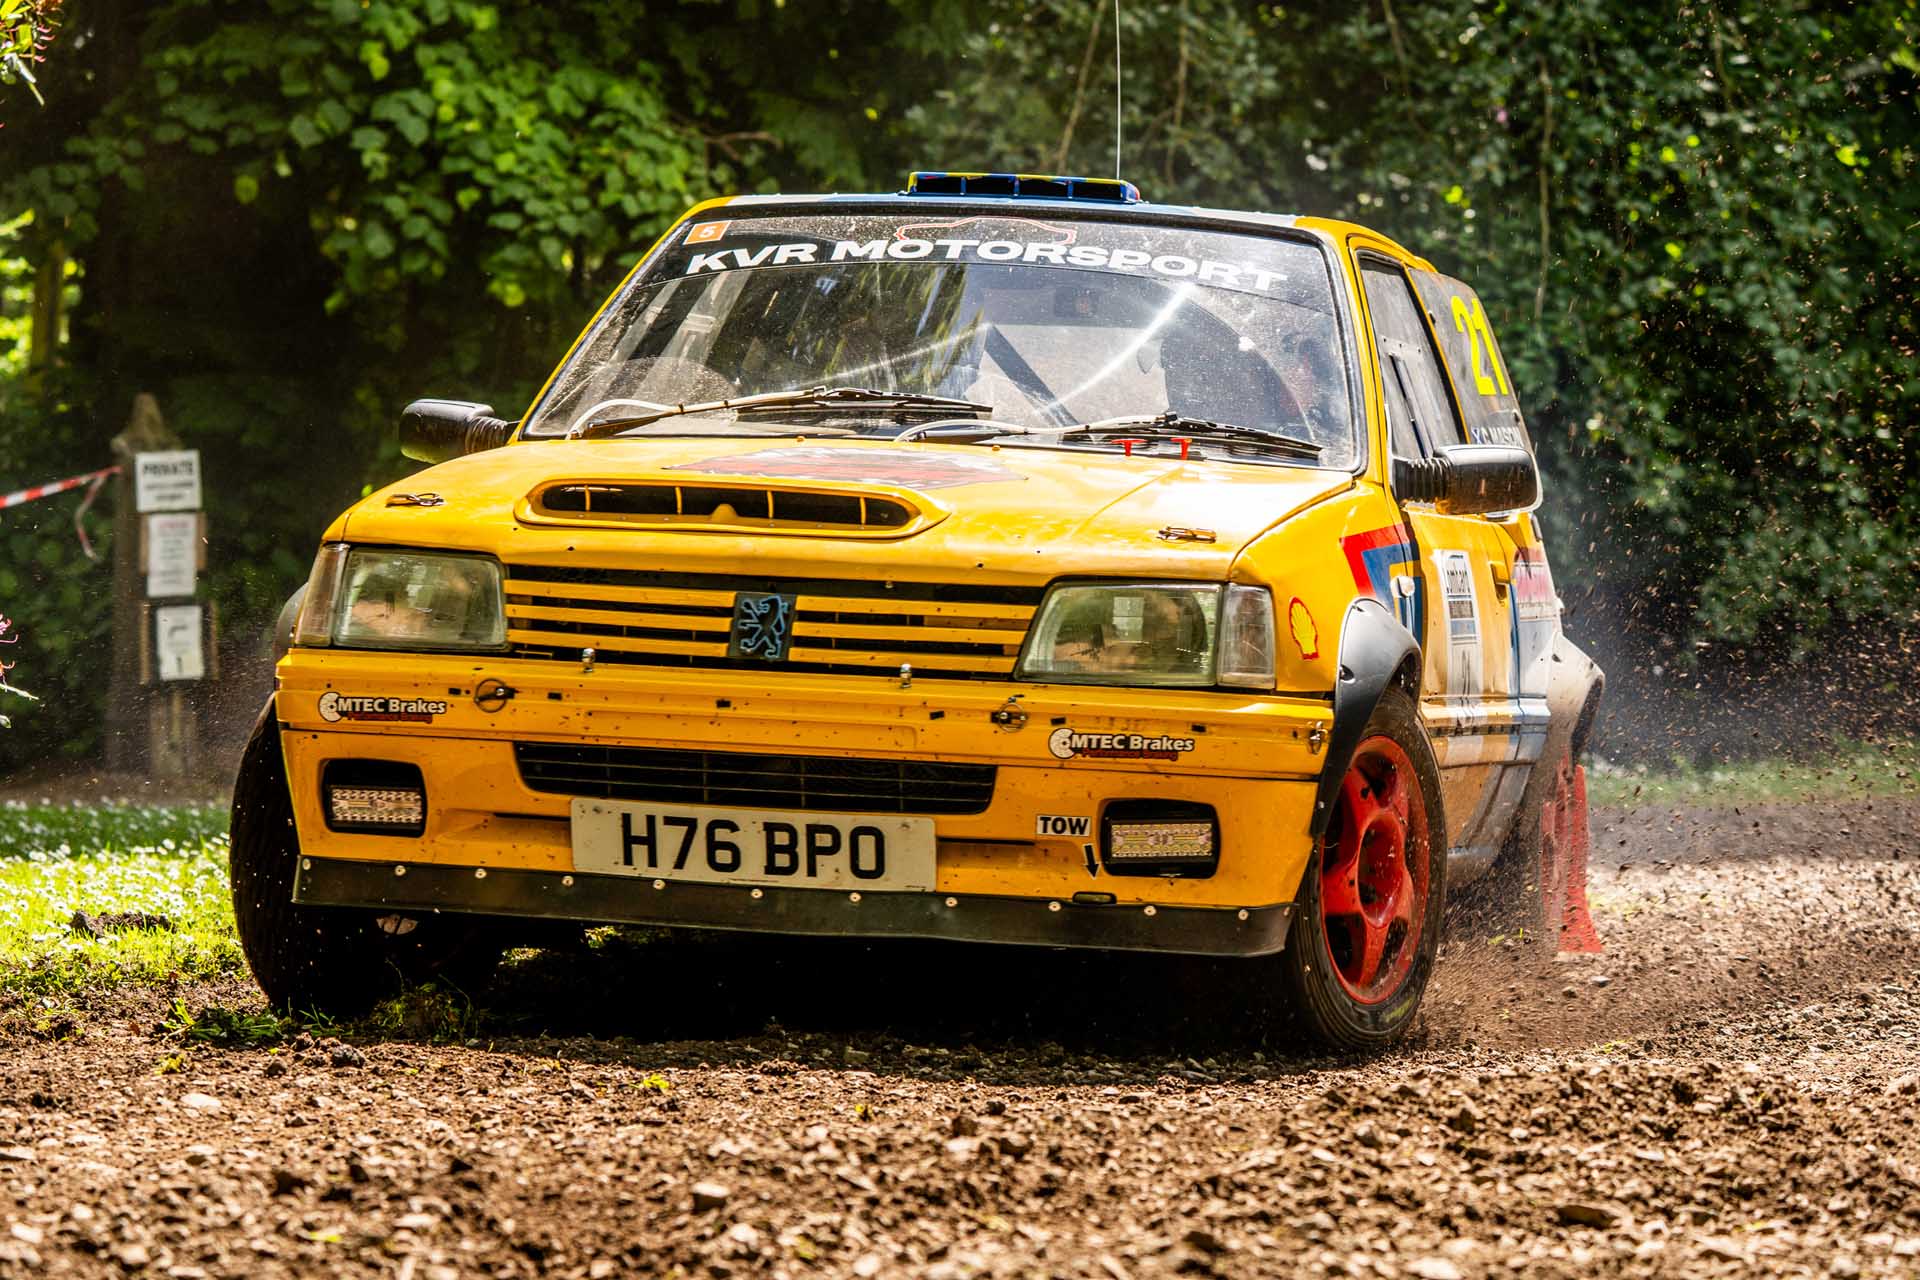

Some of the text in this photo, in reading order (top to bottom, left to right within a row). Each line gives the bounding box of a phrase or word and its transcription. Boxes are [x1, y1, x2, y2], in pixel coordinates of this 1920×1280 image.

[699, 226, 716, 237] 5
[686, 239, 1288, 291] KVR MOTORSPORT
[1451, 296, 1508, 395] 21
[337, 698, 446, 713] MTEC Brakes
[1071, 734, 1195, 751] MTEC Brakes
[1040, 816, 1089, 835] TOW
[621, 812, 886, 880] H76 BPO
